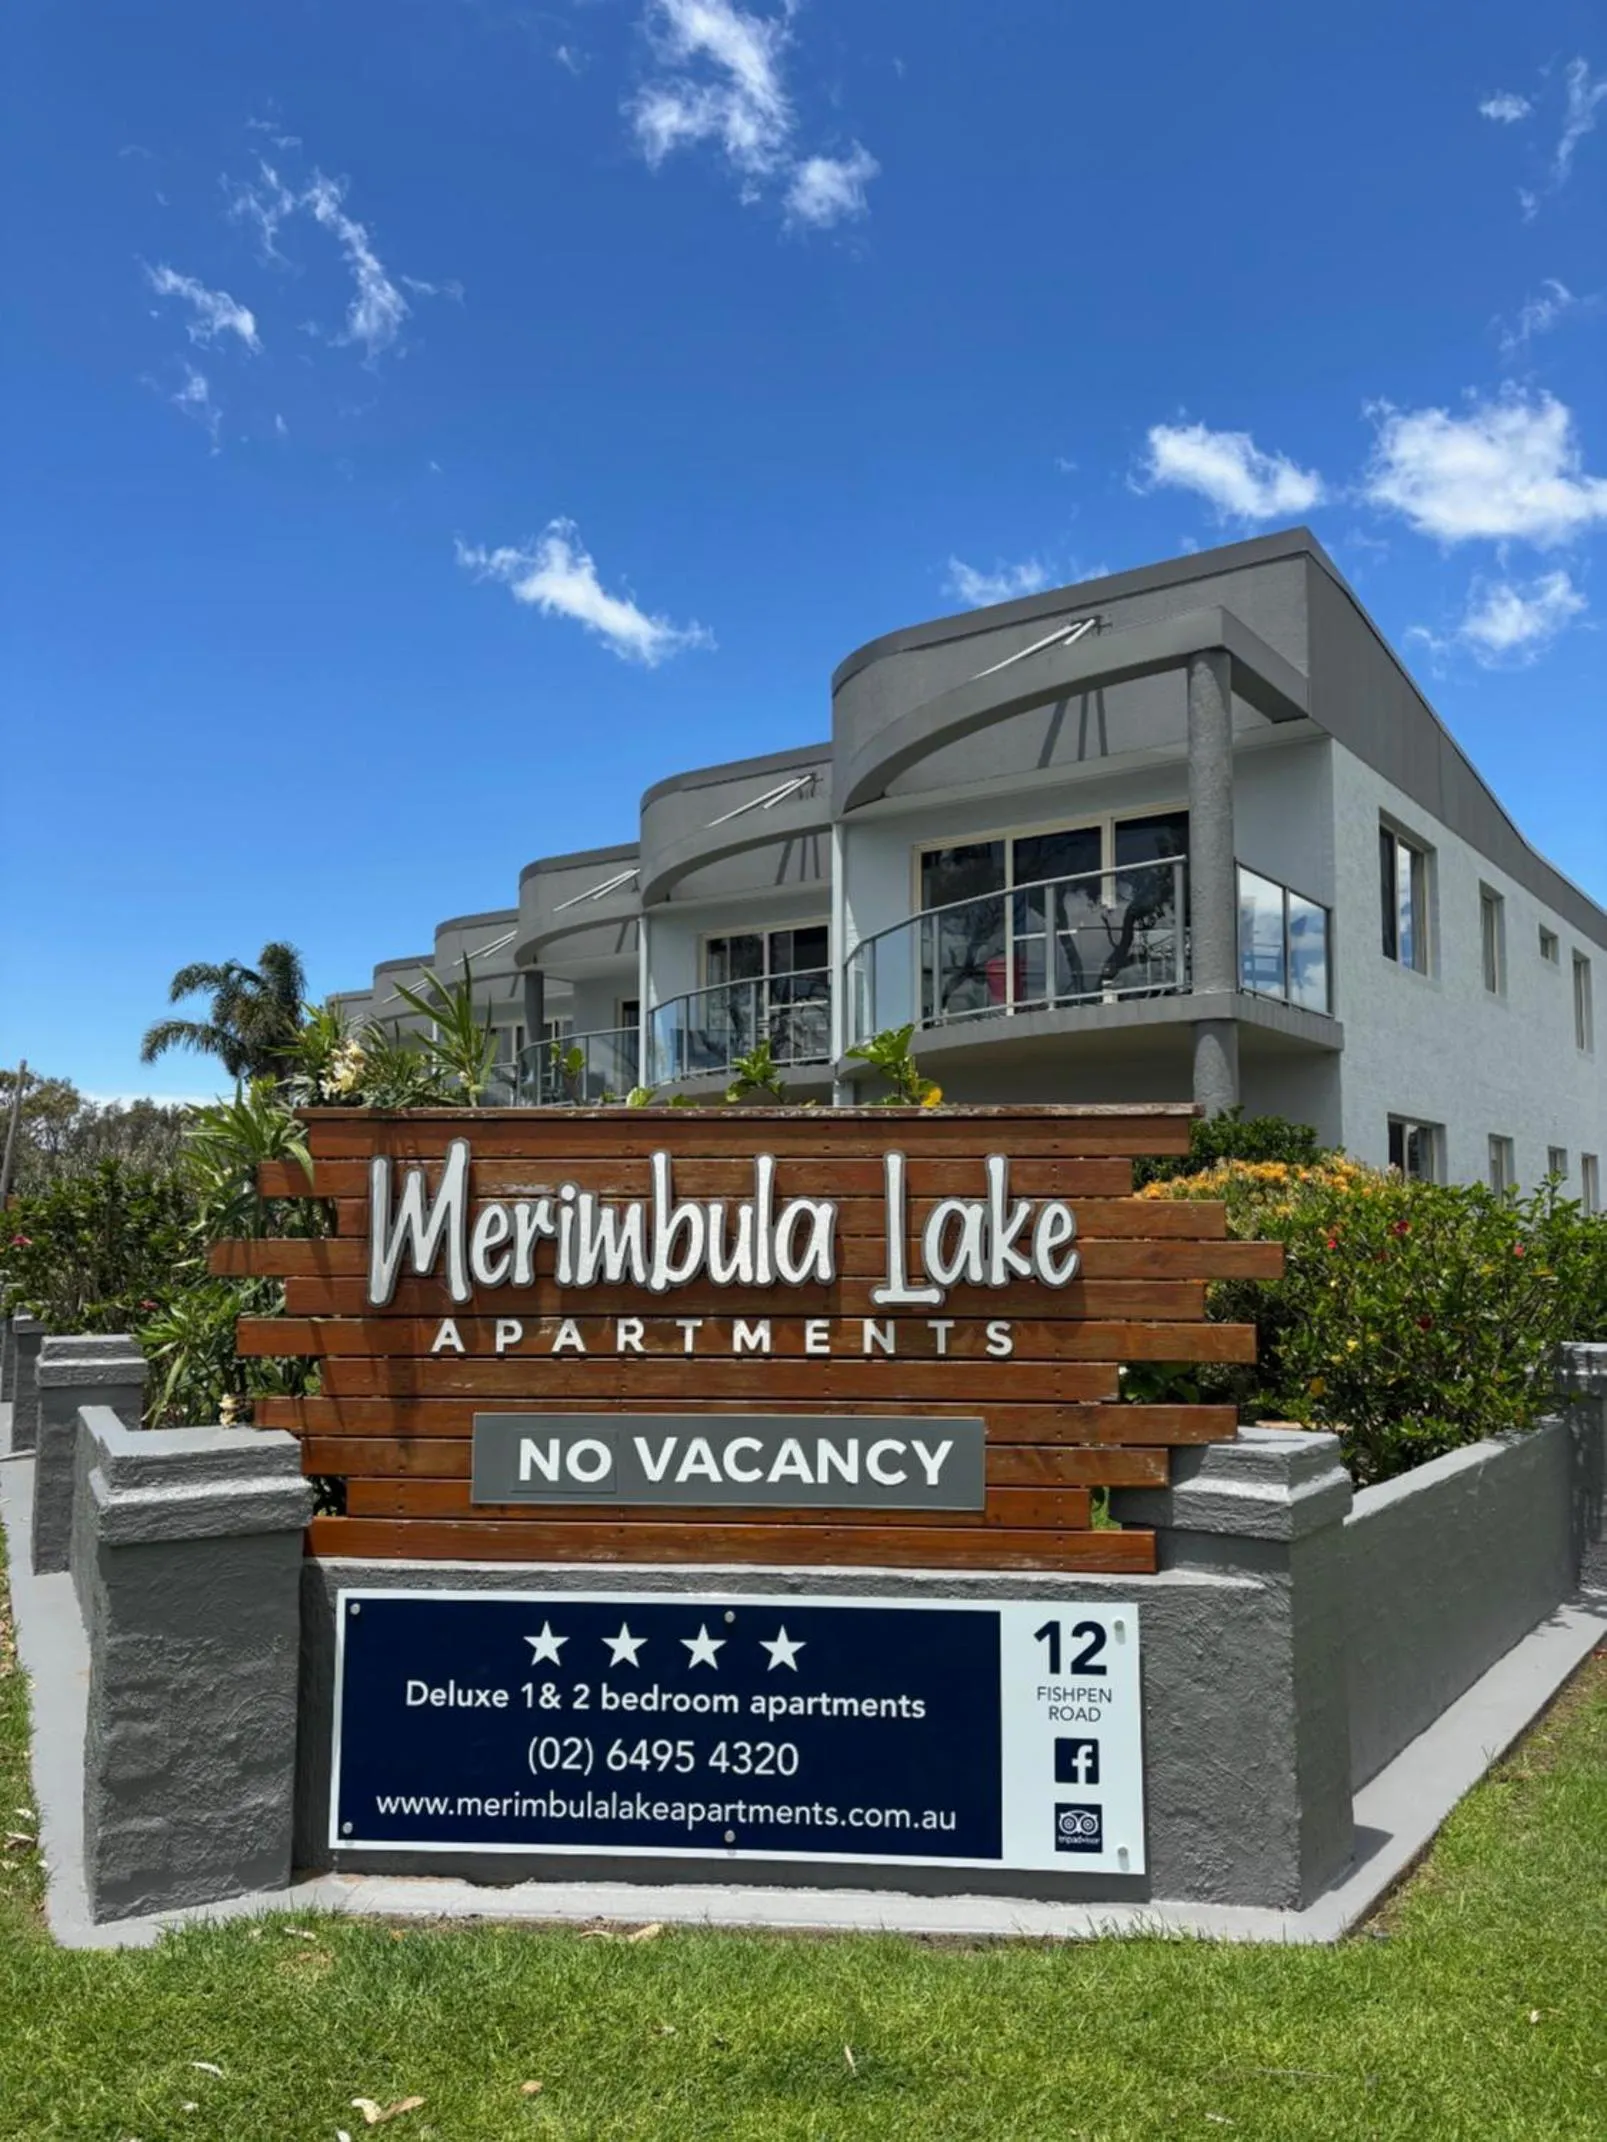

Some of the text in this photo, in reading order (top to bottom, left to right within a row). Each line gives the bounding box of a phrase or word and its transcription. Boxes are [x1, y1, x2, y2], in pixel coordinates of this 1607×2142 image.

[368, 1138, 1080, 1305] Merimbula Lake
[431, 1317, 1014, 1356] APARTMENTS
[518, 1436, 955, 1486] NO VACANCY
[1033, 1620, 1108, 1676] 12
[405, 1679, 510, 1709] Deluxe
[572, 1683, 591, 1710] 2
[601, 1682, 740, 1714] bedroom
[750, 1692, 926, 1722] apartments
[1036, 1686, 1113, 1704] FISHPEN
[1048, 1705, 1102, 1723] ROAD
[528, 1736, 800, 1777] (02) 6495 4320
[375, 1789, 957, 1831] www.merimbulalakeapartments.com.au
